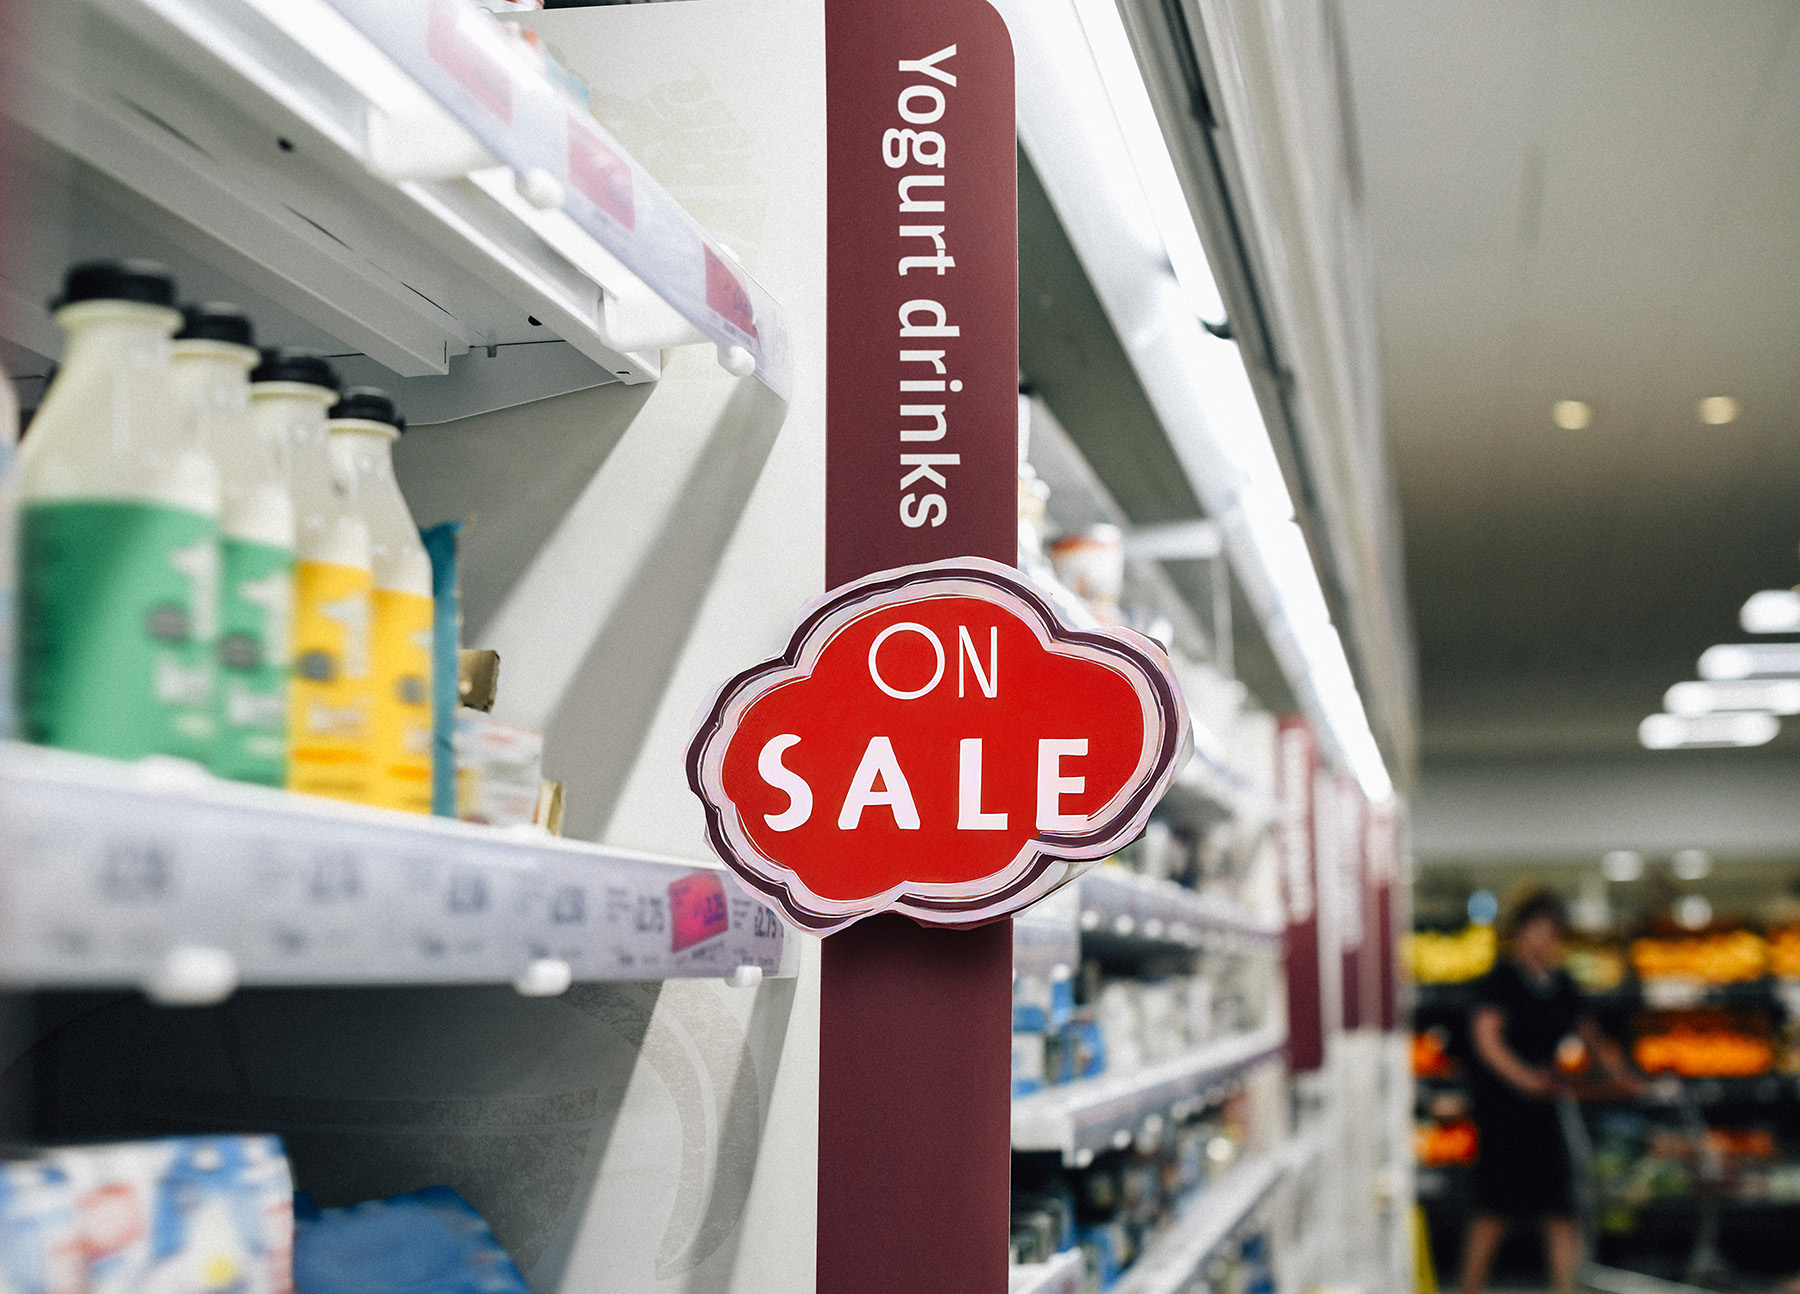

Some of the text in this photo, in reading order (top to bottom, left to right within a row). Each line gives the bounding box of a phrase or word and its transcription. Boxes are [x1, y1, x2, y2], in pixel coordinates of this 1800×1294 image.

[882, 43, 962, 530] Yogurt drinks
[867, 621, 998, 700] ON
[757, 733, 1089, 832] SALE
